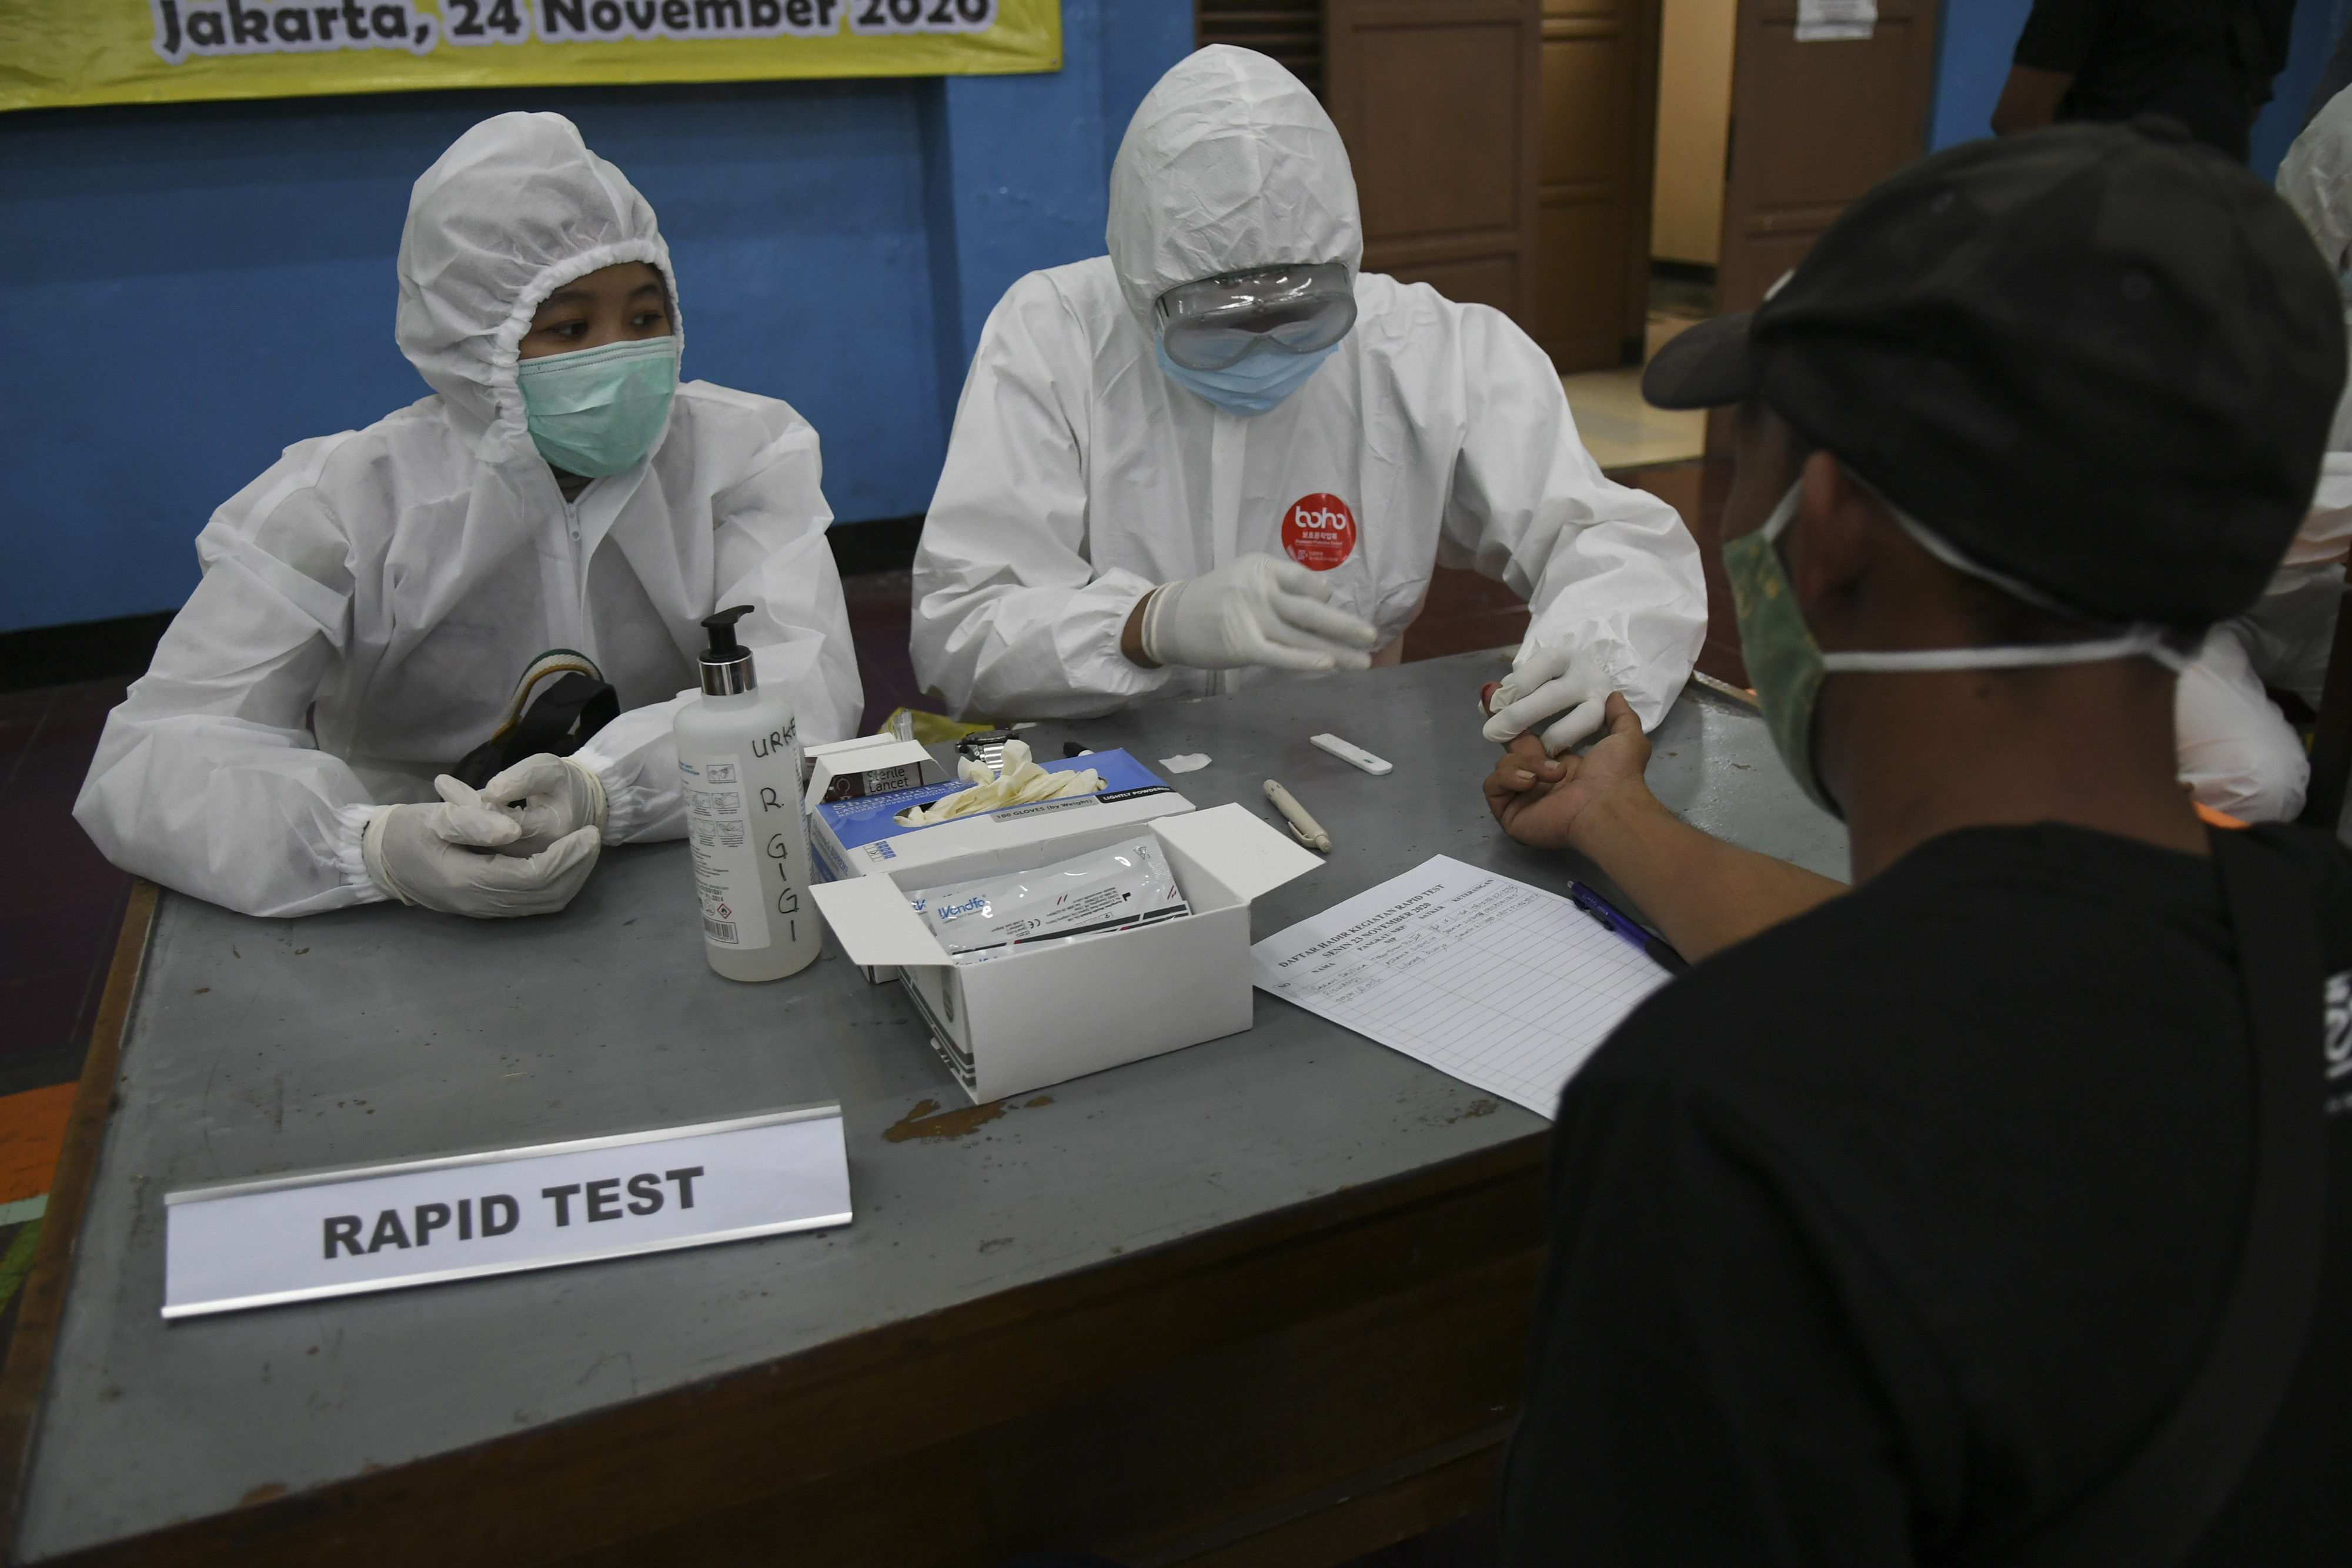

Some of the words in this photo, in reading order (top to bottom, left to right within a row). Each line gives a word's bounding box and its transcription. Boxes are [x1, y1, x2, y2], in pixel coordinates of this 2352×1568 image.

[162, 0, 431, 54] Jakarta,
[452, 0, 521, 36] 24
[543, 0, 835, 33] November
[1295, 506, 1347, 530] boho
[867, 766, 906, 781] Sterile
[868, 776, 910, 793] Lancet
[835, 804, 869, 815] LATEX
[871, 788, 946, 806] EXAMINATION
[1013, 806, 1045, 817] GLOVES
[1060, 798, 1093, 808] Weight)
[1102, 792, 1131, 801] LIGHTLY
[1451, 879, 1494, 902] KETERANGAN
[1418, 905, 1446, 921] SATKER
[1278, 947, 1321, 968] DAFTAR
[1317, 929, 1351, 950] HADIR
[1349, 907, 1397, 934] KEGIATAN
[1394, 895, 1424, 911] RAPID
[1420, 884, 1445, 898] TEST
[1322, 941, 1352, 958] SENIN
[1350, 936, 1364, 947] 23
[1361, 911, 1414, 940] NOVEMBER
[1411, 902, 1432, 914] 2020
[1311, 962, 1336, 974] NAMA
[322, 1193, 521, 1261] RAPID
[541, 1165, 706, 1229] TEST
